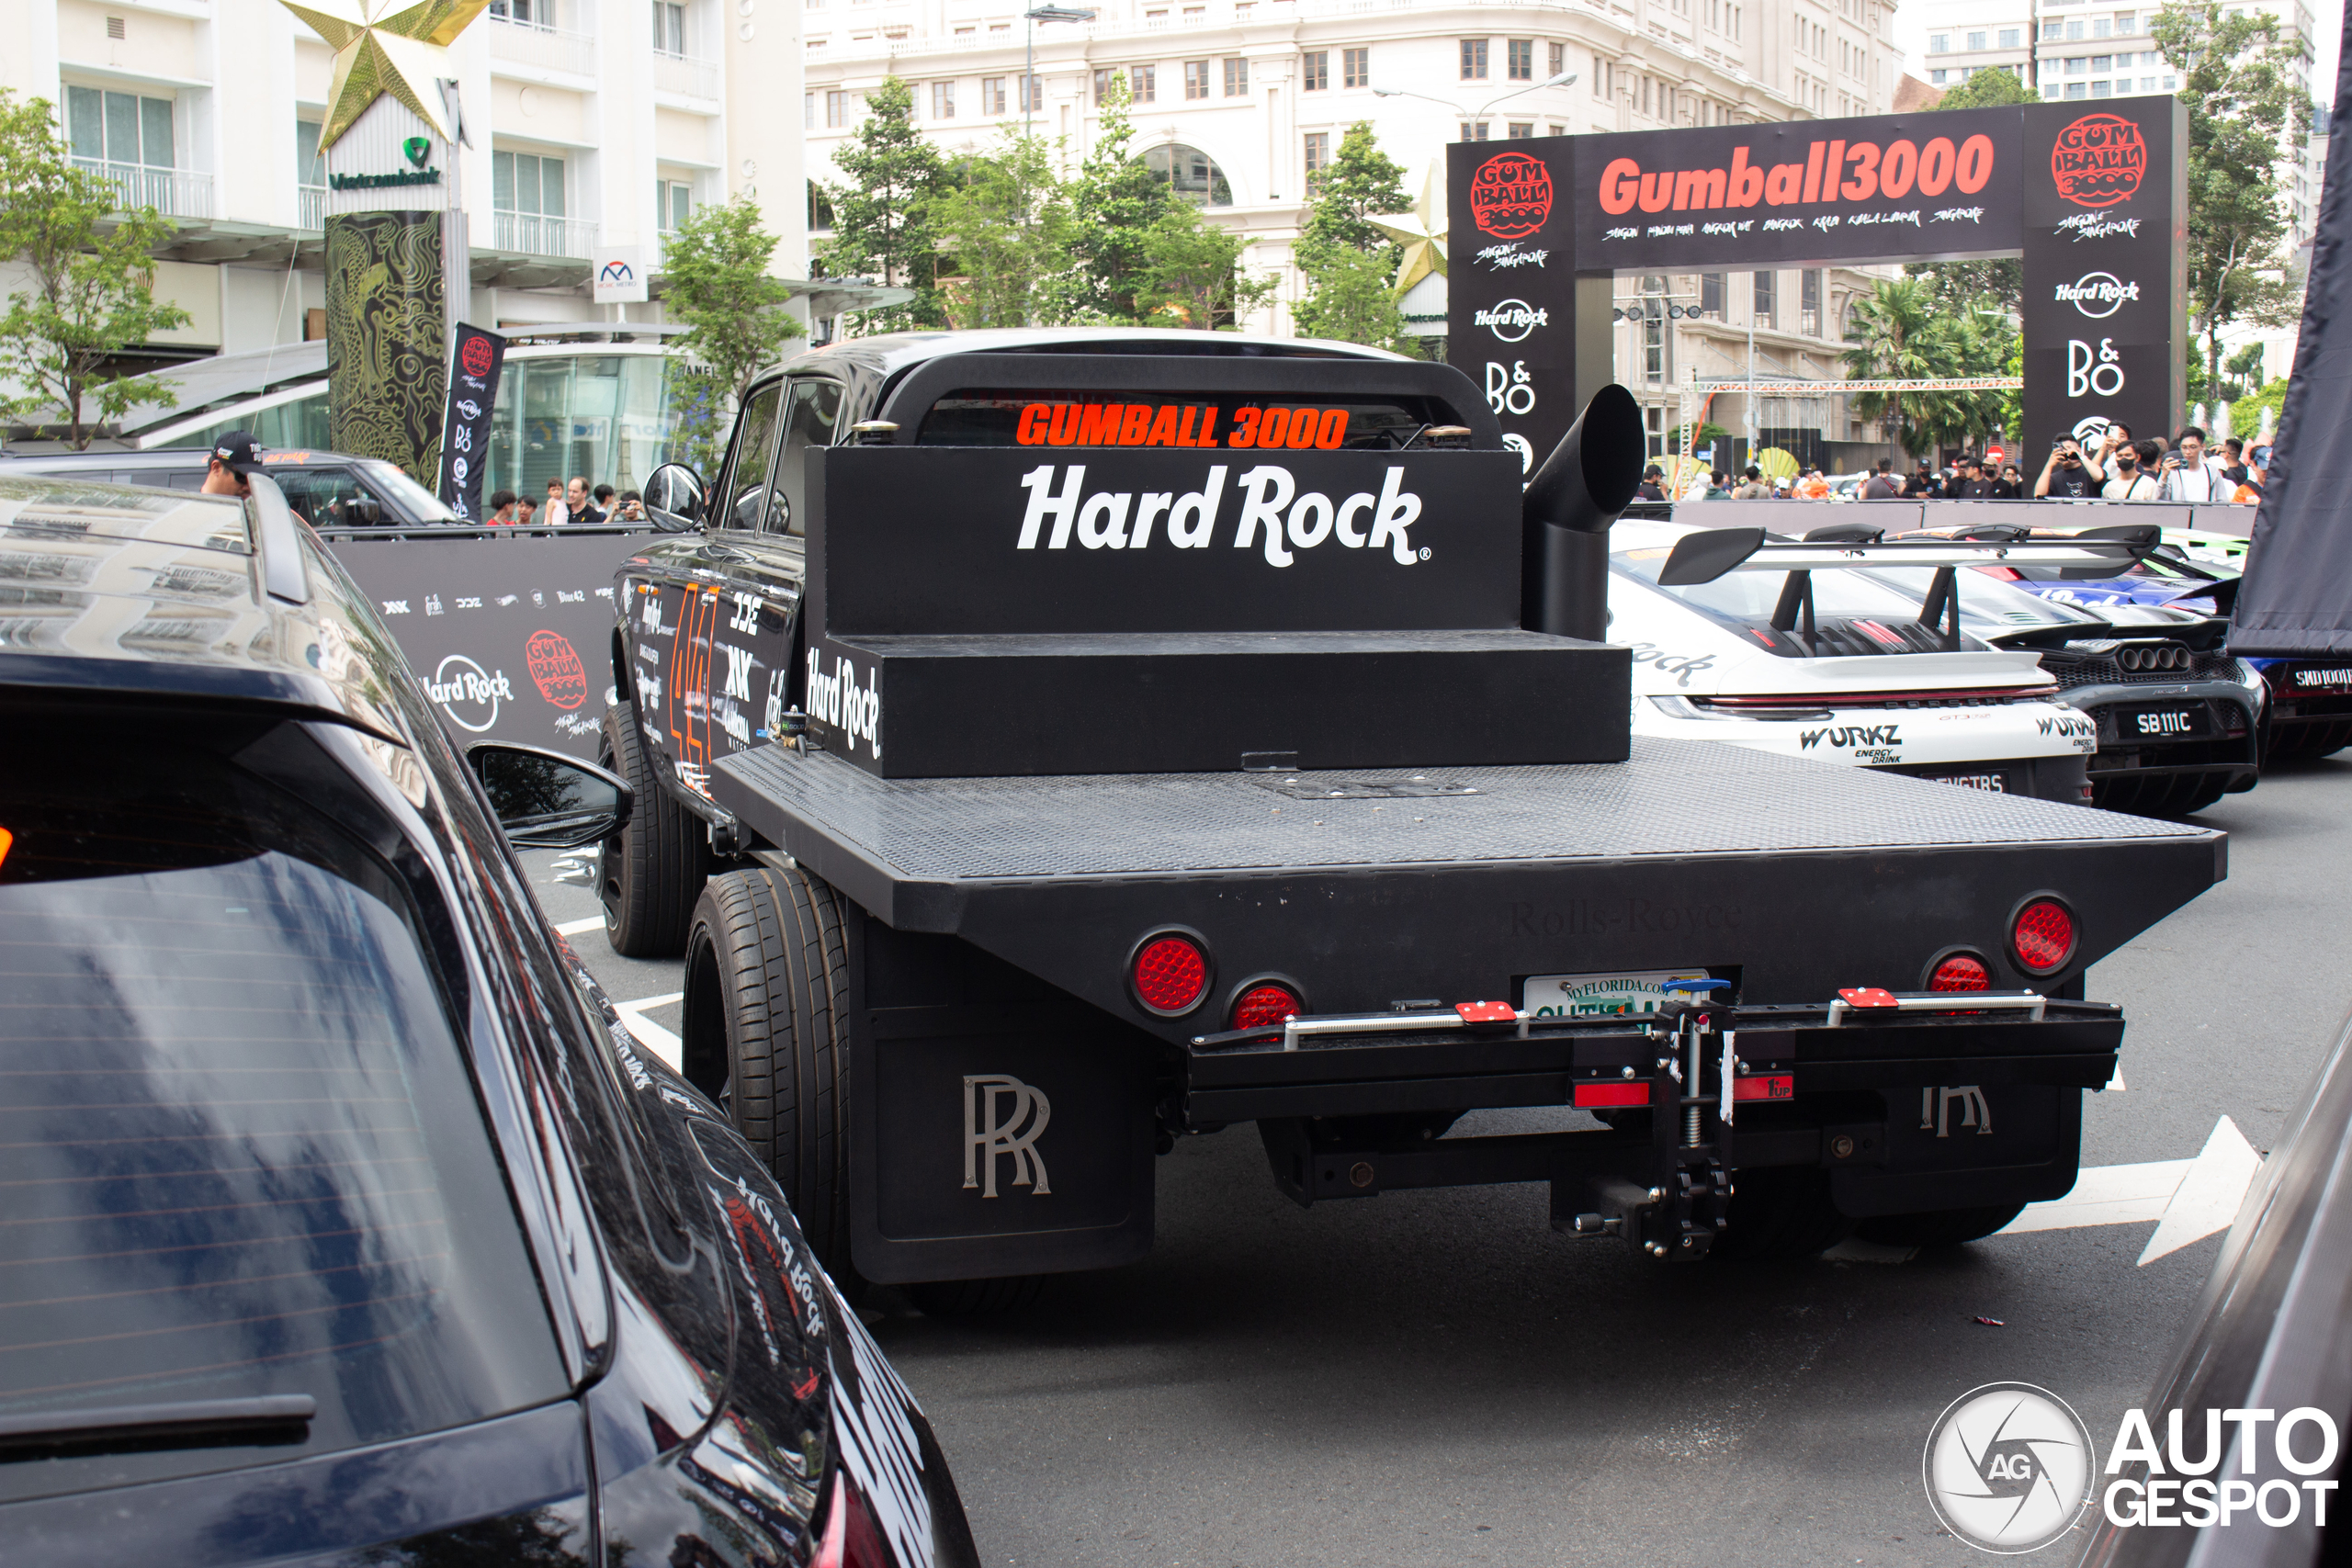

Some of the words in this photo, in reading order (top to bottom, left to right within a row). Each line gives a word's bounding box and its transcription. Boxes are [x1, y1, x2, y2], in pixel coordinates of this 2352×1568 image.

[2059, 124, 2138, 150] GUM
[2055, 147, 2140, 173] BALL
[329, 166, 441, 191] Vietcombank
[1476, 163, 1545, 186] GUM
[1599, 133, 1994, 215] Gumball3000
[2058, 172, 2138, 197] 3000
[1474, 183, 1546, 207] BALL
[1477, 207, 1547, 230] 3000
[1929, 207, 1985, 224] SINGAPORE
[2053, 209, 2098, 235] SAIGON
[2073, 219, 2142, 243] SINGAPORE
[1473, 241, 1511, 265] SAIGON
[1489, 249, 1549, 272] SINGAPORE
[2054, 283, 2099, 301] Hard
[2098, 281, 2140, 303] Rock
[1474, 310, 1512, 326] Hard
[1511, 308, 1548, 328] Rock
[1015, 403, 1219, 447] GUMBALL
[1227, 407, 1350, 450] 3000
[1016, 465, 1228, 550] Hard
[1233, 465, 1422, 569] Rock
[526, 637, 573, 662] GUM
[531, 656, 583, 682] BALL
[462, 669, 514, 705] Rock
[540, 678, 587, 703] 3000
[806, 646, 842, 728] Hard
[842, 658, 879, 761] Rock
[1886, 695, 2015, 711] PORSCHE
[1799, 724, 1903, 751] WURKZ
[1854, 749, 1894, 758] ENERGY
[1871, 755, 1903, 764] DRINK
[1510, 897, 1743, 941] Rolls-Royce
